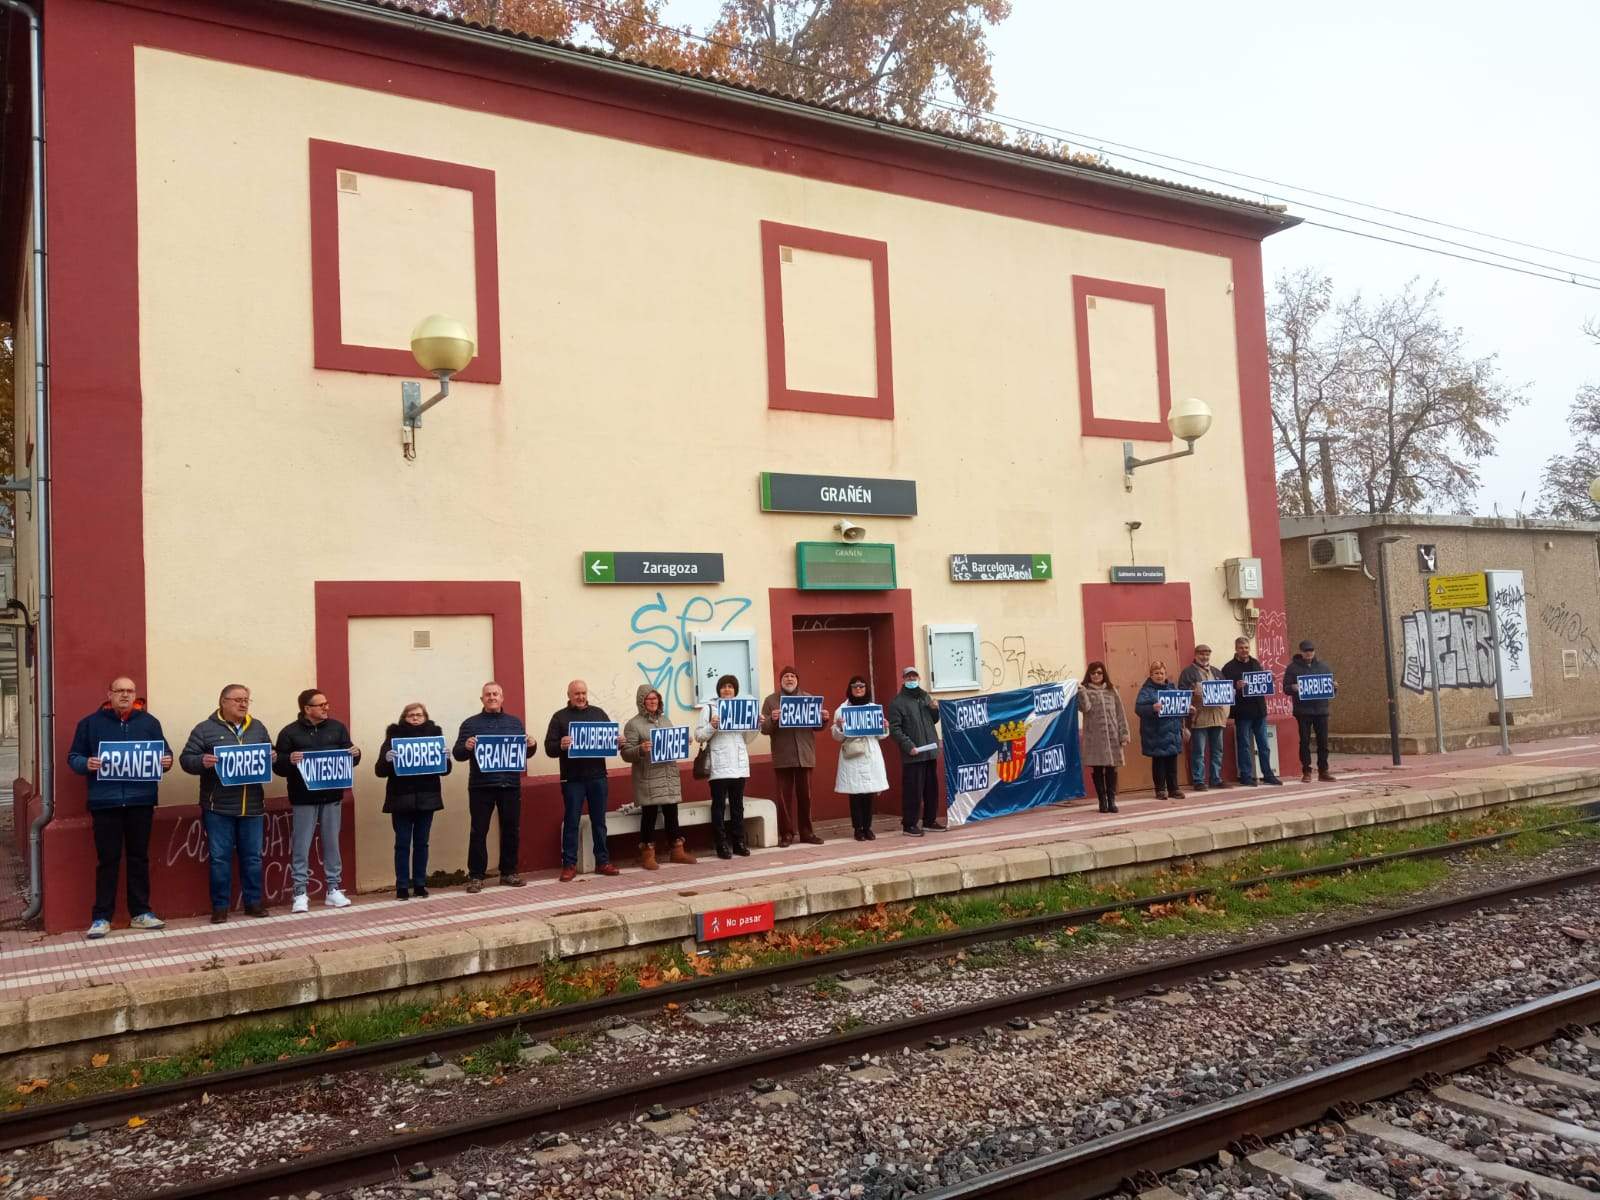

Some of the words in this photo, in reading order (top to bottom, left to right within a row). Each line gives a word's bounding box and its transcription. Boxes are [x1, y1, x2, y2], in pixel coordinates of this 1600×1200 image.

[820, 485, 872, 504] GRAÑÉN
[642, 561, 698, 577] Zaragoza
[971, 562, 1015, 573] Barcelona
[1244, 672, 1272, 685] ALBERO
[1248, 683, 1268, 695] BAJO
[780, 699, 822, 726] GRAÑÉN
[1159, 691, 1191, 714] GRAÑÉN
[719, 700, 759, 731] CALLEN
[569, 726, 618, 750] ALCUBIERRE
[653, 727, 686, 761] CURBE
[99, 743, 163, 778] GRAÑÉN
[220, 749, 266, 778] TORRES
[396, 742, 442, 768] ROBRES
[475, 737, 526, 769] GRAÑÉN
[958, 767, 988, 792] TRENES
[726, 918, 737, 928] No
[739, 915, 762, 928] pasar
